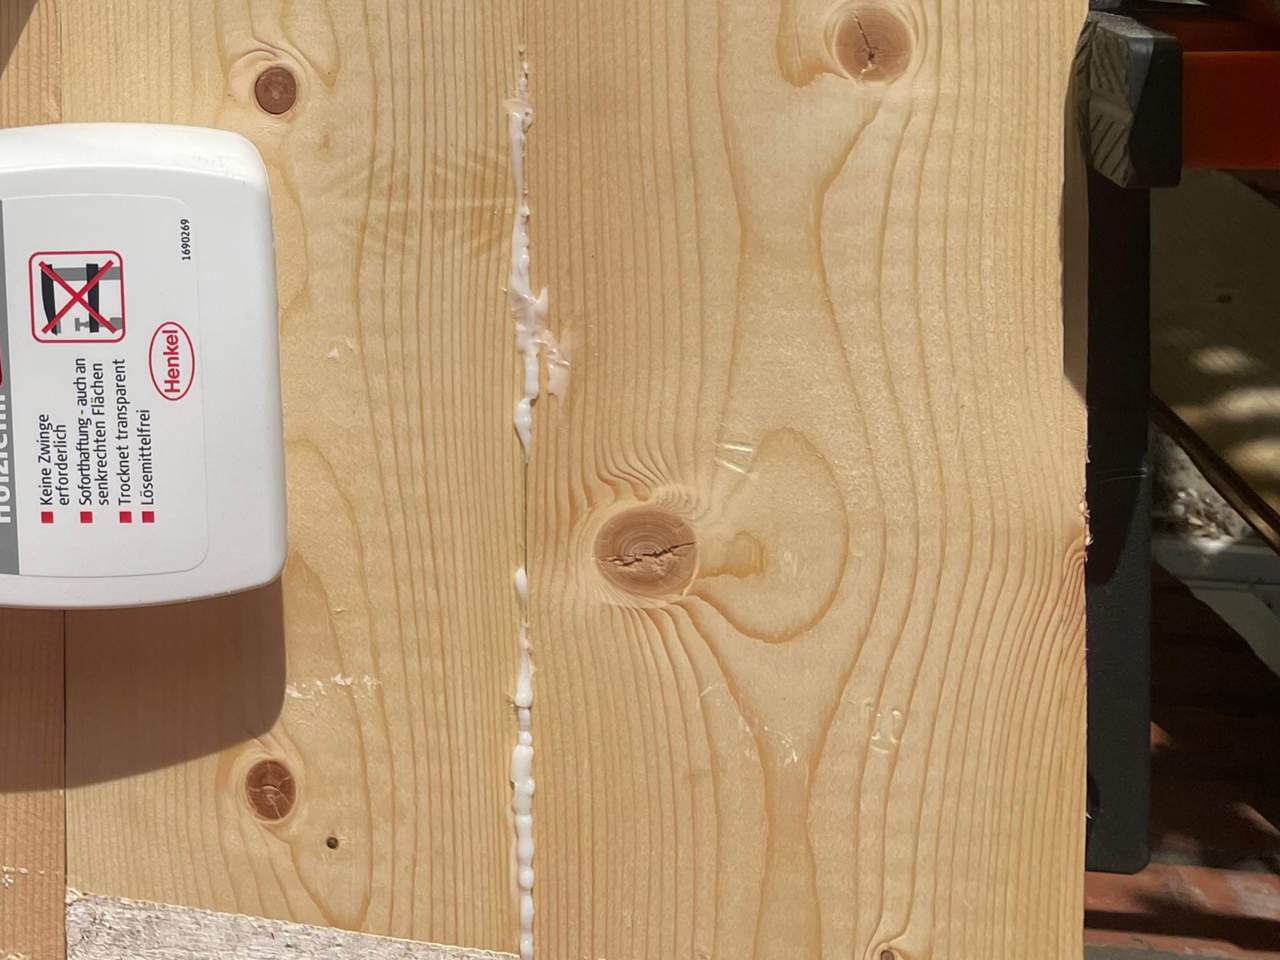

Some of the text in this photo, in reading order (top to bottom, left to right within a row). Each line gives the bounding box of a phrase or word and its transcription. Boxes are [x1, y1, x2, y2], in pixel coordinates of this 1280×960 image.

[180, 218, 191, 260] 1690269
[74, 376, 89, 407] auch
[76, 358, 87, 374] an
[161, 330, 181, 393] Henkel
[37, 414, 54, 505] Keine Zwinge
[53, 425, 69, 505] erforderlich
[76, 418, 94, 505] Soforthaftung
[90, 363, 109, 505] senkrechten Flächen
[112, 359, 131, 505] Trocknet transparent
[137, 409, 154, 505] Lösemittelfrei
